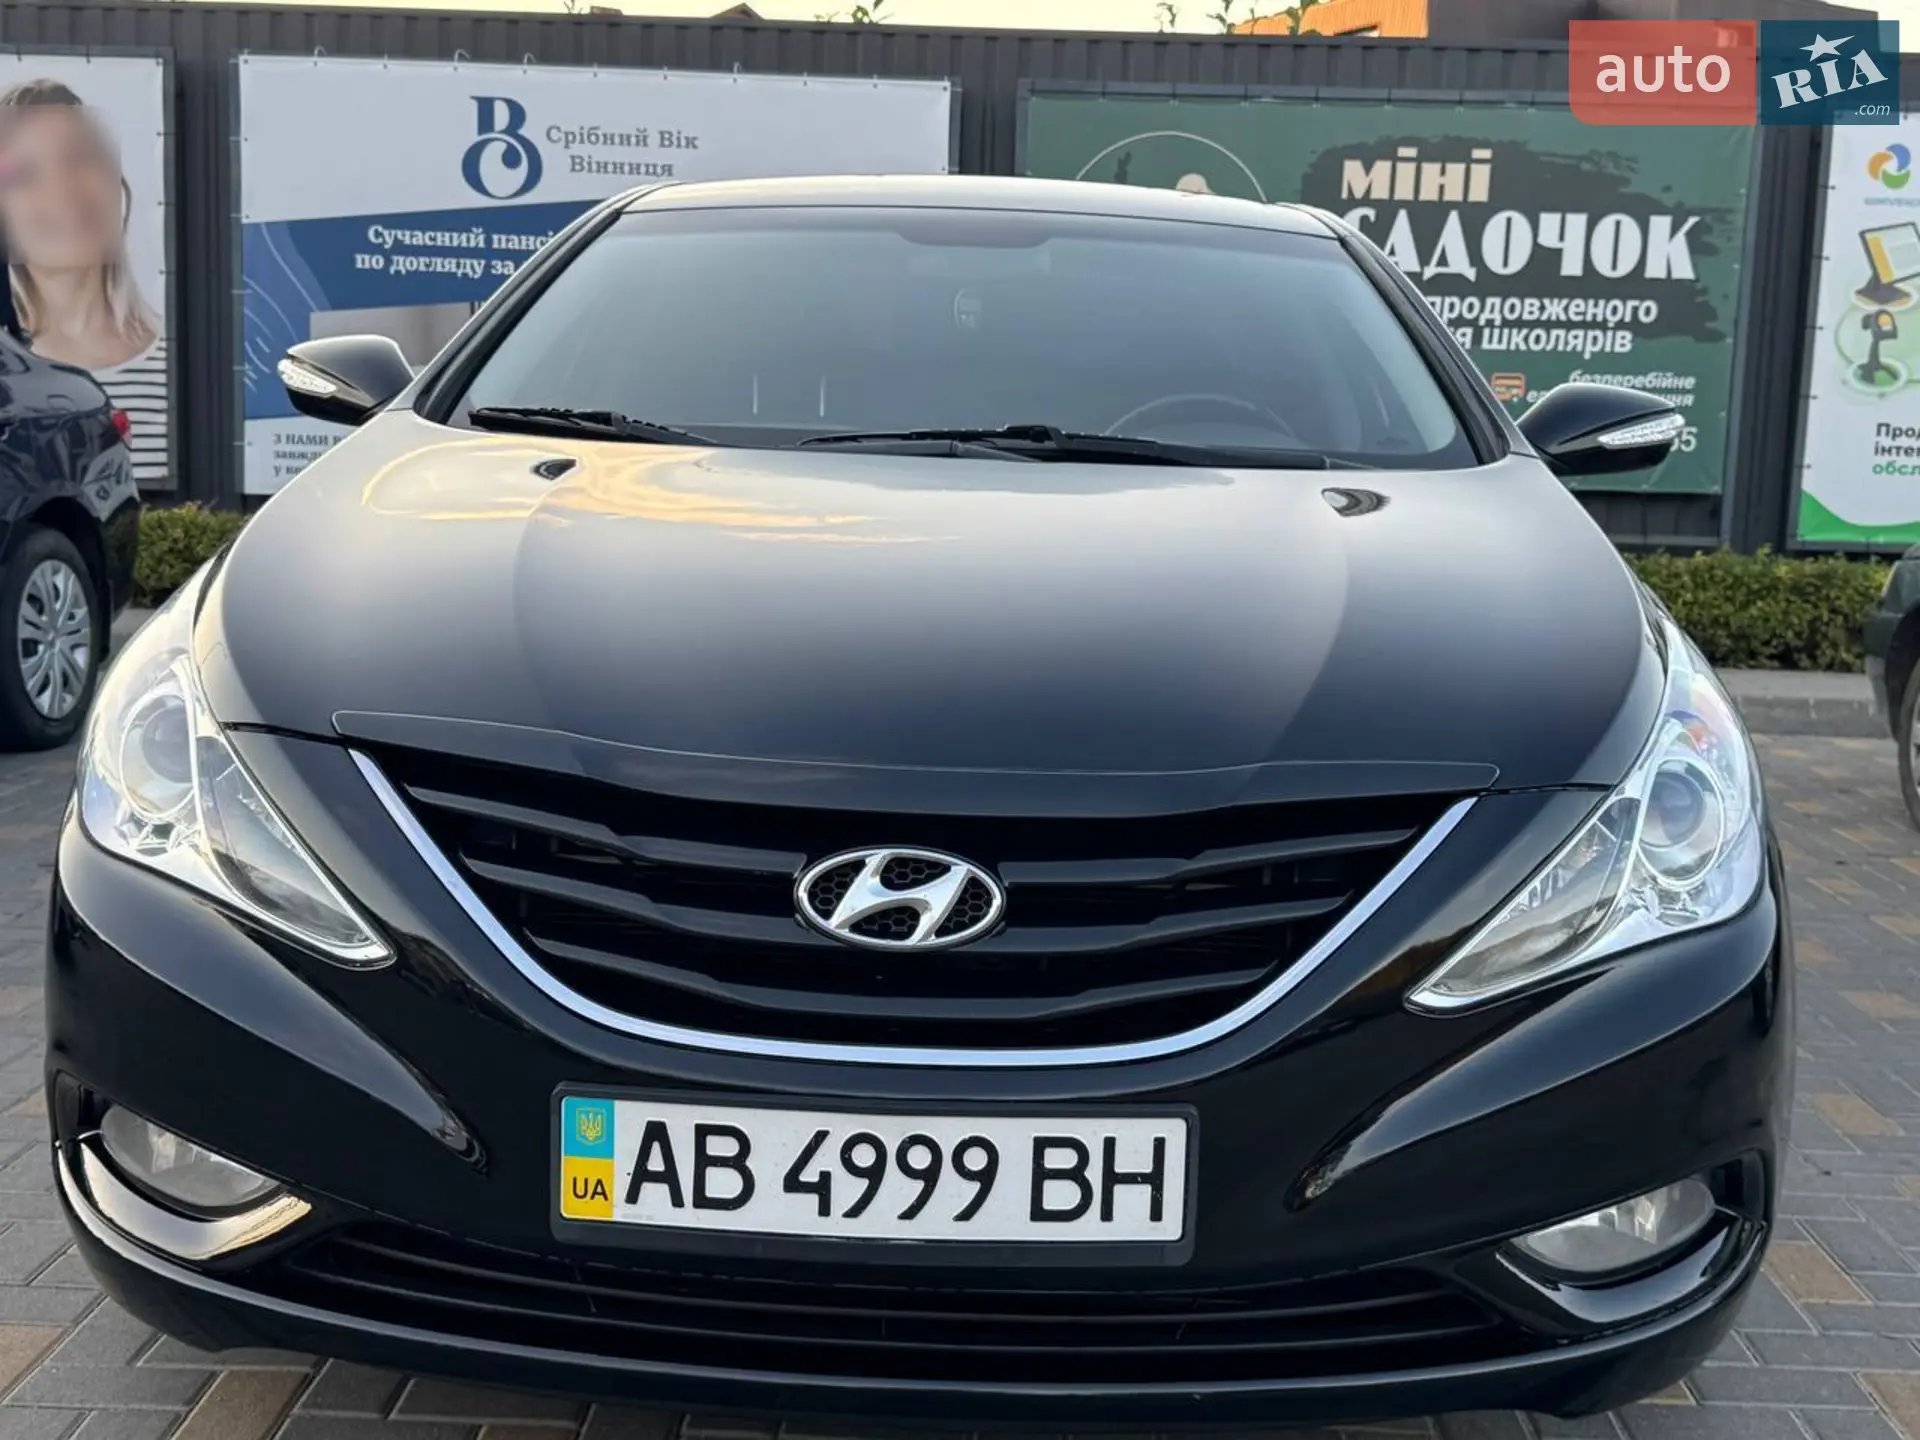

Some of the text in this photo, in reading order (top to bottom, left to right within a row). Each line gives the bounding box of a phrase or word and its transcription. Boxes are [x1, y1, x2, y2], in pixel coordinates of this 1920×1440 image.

[545, 125, 700, 150] Срібний Вік
[568, 154, 675, 178] Вінниця
[1341, 147, 1493, 203] міні
[367, 225, 486, 250] Сучасний
[354, 253, 517, 279] по догляду за
[1480, 323, 1634, 360] школярів
[623, 1119, 1166, 1222] AB 4999 BH
[572, 1177, 609, 1202] UA
